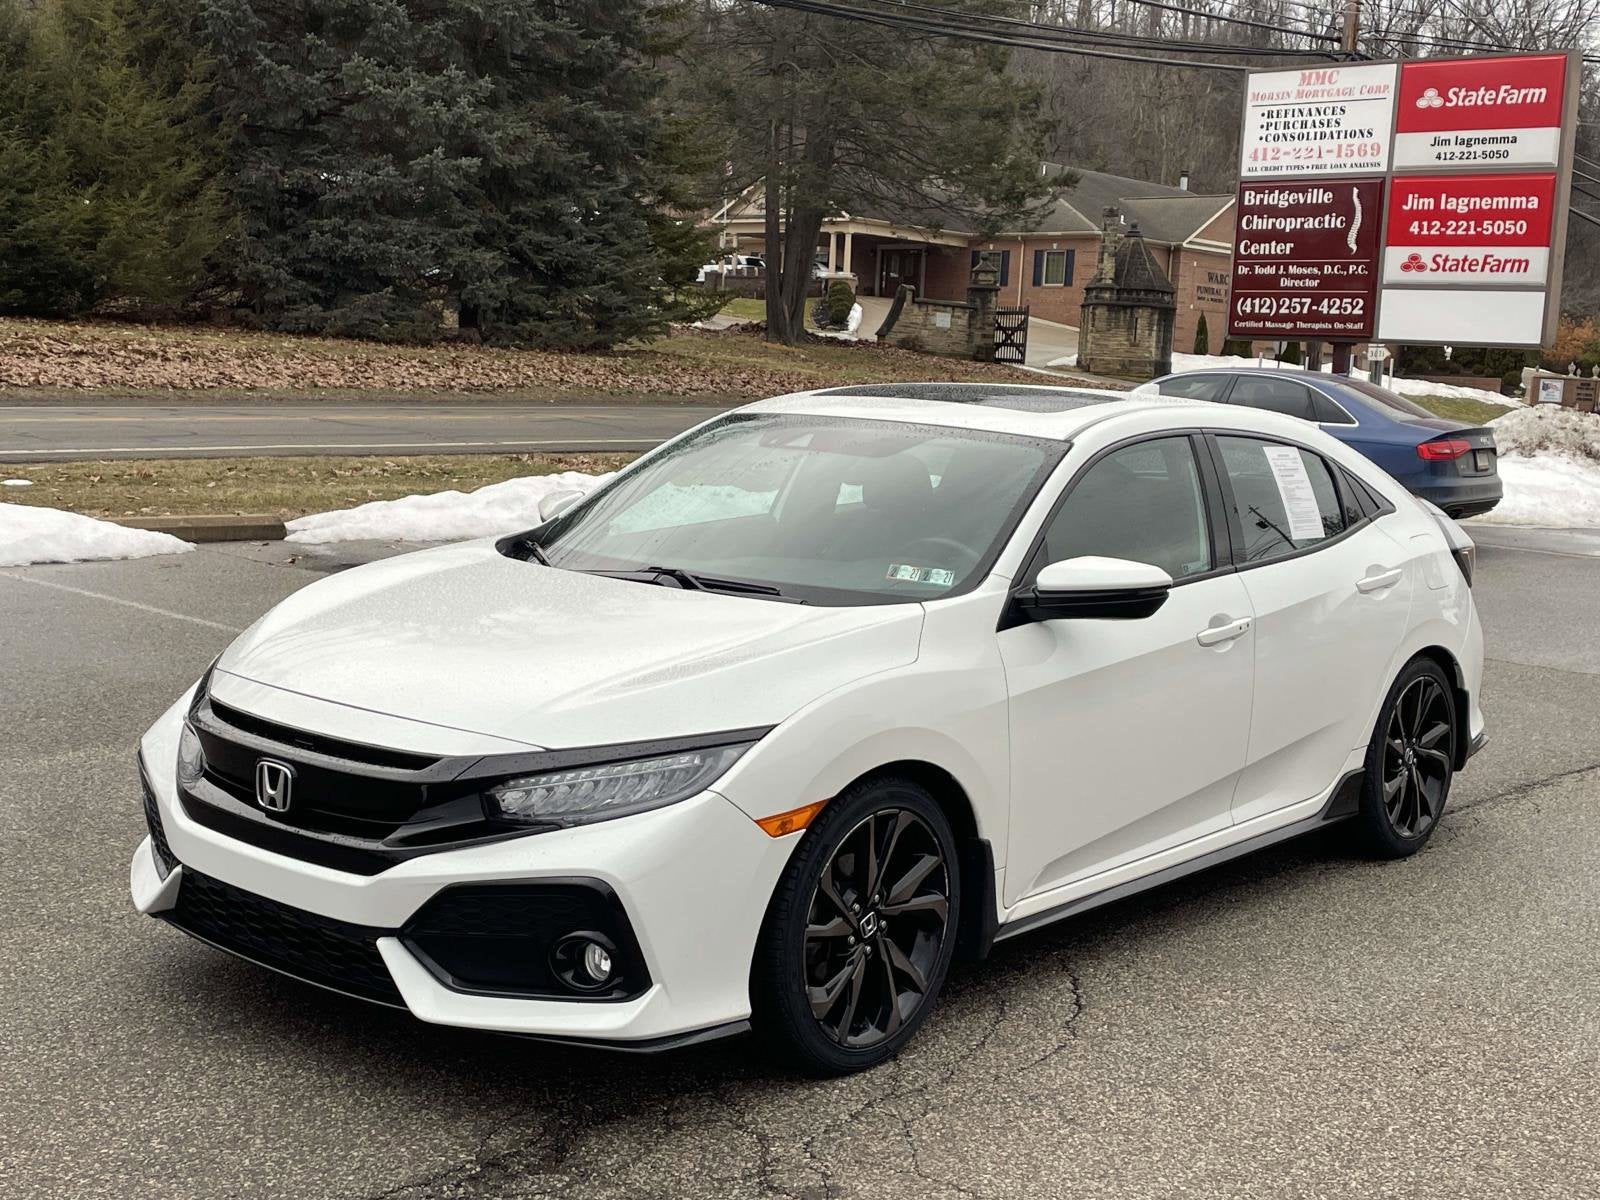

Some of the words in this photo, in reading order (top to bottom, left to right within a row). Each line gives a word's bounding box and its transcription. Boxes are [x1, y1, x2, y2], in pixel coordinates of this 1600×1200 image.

[1298, 70, 1340, 86] MMC
[1266, 106, 1346, 119] REFINANCES
[1266, 118, 1341, 130] PURCHASES
[1265, 128, 1374, 142] CONSOLIDATIONS
[1430, 135, 1451, 148] Jim
[1455, 134, 1517, 147] Iagnemma
[1249, 143, 1381, 162] 412-221-1569
[1435, 149, 1509, 161] 412-221-5050
[1244, 189, 1333, 208] Bridgeville
[1402, 193, 1434, 211] Jim
[1440, 193, 1539, 213] Iagnemma
[1241, 213, 1346, 232] Chiropractic
[1409, 220, 1528, 235] 412-221-5050
[1239, 240, 1294, 255] Center
[1238, 266, 1251, 274] Dr.
[1254, 265, 1275, 274] Todd
[1278, 265, 1286, 275] J.
[1289, 265, 1321, 275] Moses,
[1324, 265, 1346, 275] D.C.,
[1349, 265, 1368, 275] P.C.
[1280, 278, 1320, 287] Director
[1237, 297, 1276, 316] (412)
[1280, 298, 1364, 315] 257-4252
[1265, 321, 1294, 329] Massage
